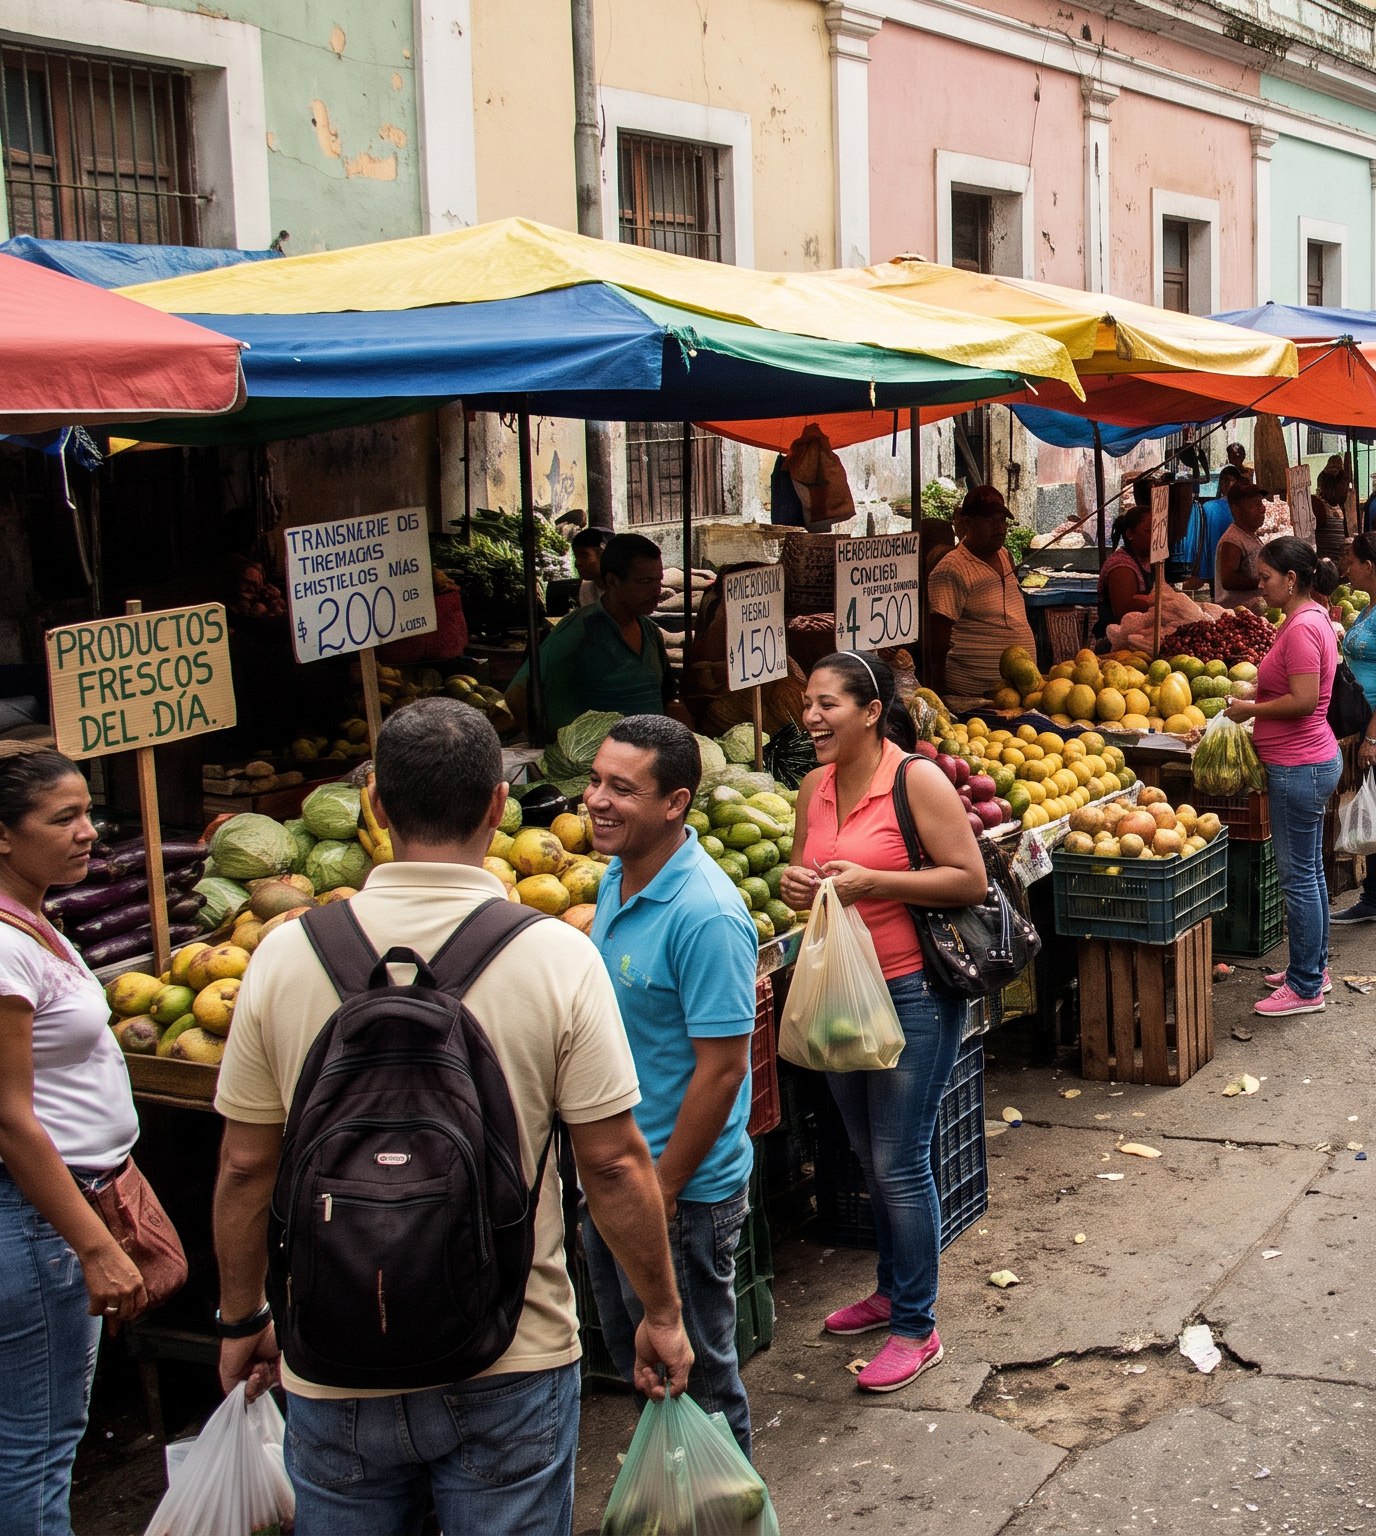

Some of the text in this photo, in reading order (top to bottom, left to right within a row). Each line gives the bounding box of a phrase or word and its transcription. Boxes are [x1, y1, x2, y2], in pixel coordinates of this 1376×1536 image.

[55, 608, 224, 670] PRODUCTOS
[318, 585, 396, 657] 200
[77, 651, 213, 709] FRESCOS
[737, 625, 777, 682] 150
[78, 709, 140, 753] DEL
